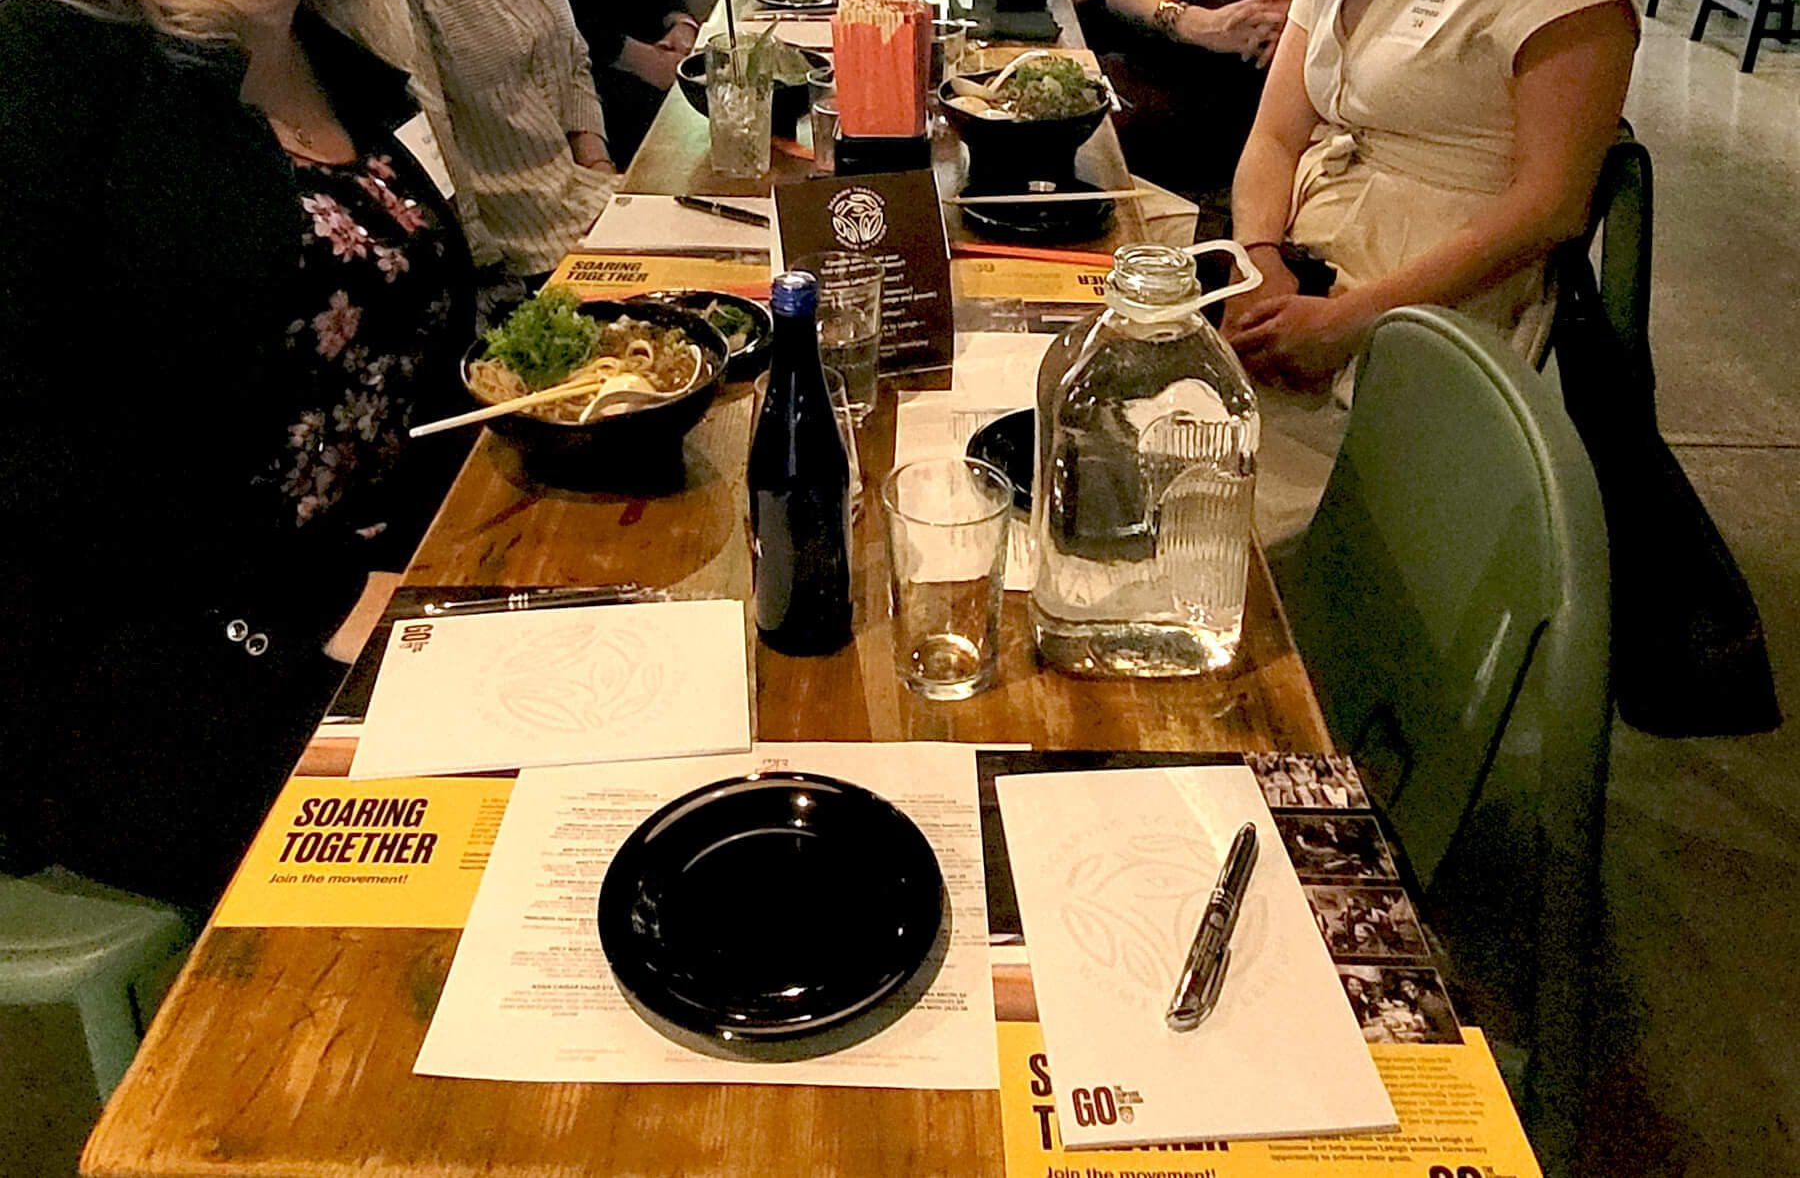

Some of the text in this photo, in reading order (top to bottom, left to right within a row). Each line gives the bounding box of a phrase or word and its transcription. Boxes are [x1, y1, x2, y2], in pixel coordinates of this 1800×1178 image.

[566, 270, 649, 283] TOGETHER
[571, 261, 643, 271] SOARING
[293, 798, 429, 828] SOARING
[279, 831, 438, 864] TOGETHER
[268, 873, 409, 885] Join the movement!
[1072, 1086, 1117, 1127] GO
